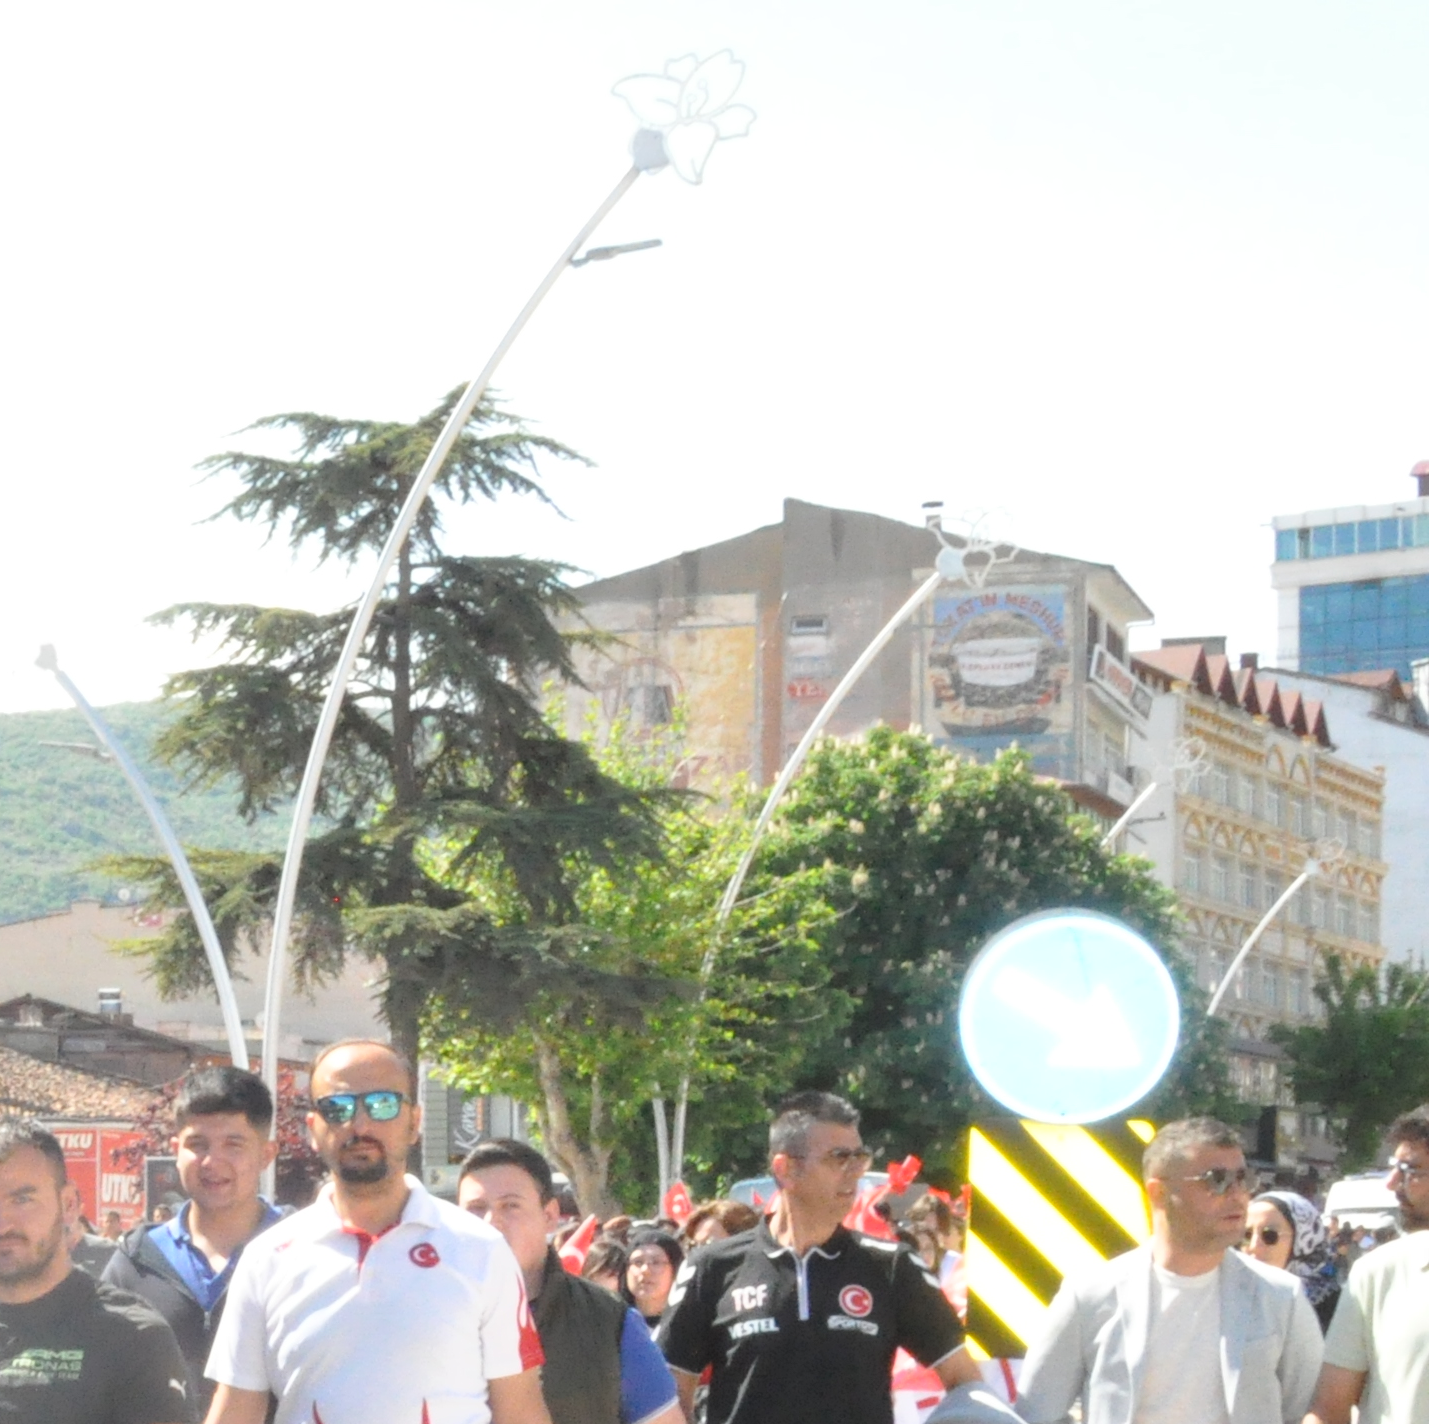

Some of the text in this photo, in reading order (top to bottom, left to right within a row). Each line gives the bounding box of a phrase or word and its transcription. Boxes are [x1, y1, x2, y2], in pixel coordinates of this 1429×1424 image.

[57, 1132, 94, 1149] TKU
[732, 1284, 768, 1312] TCF
[728, 1317, 780, 1340] VESTEL
